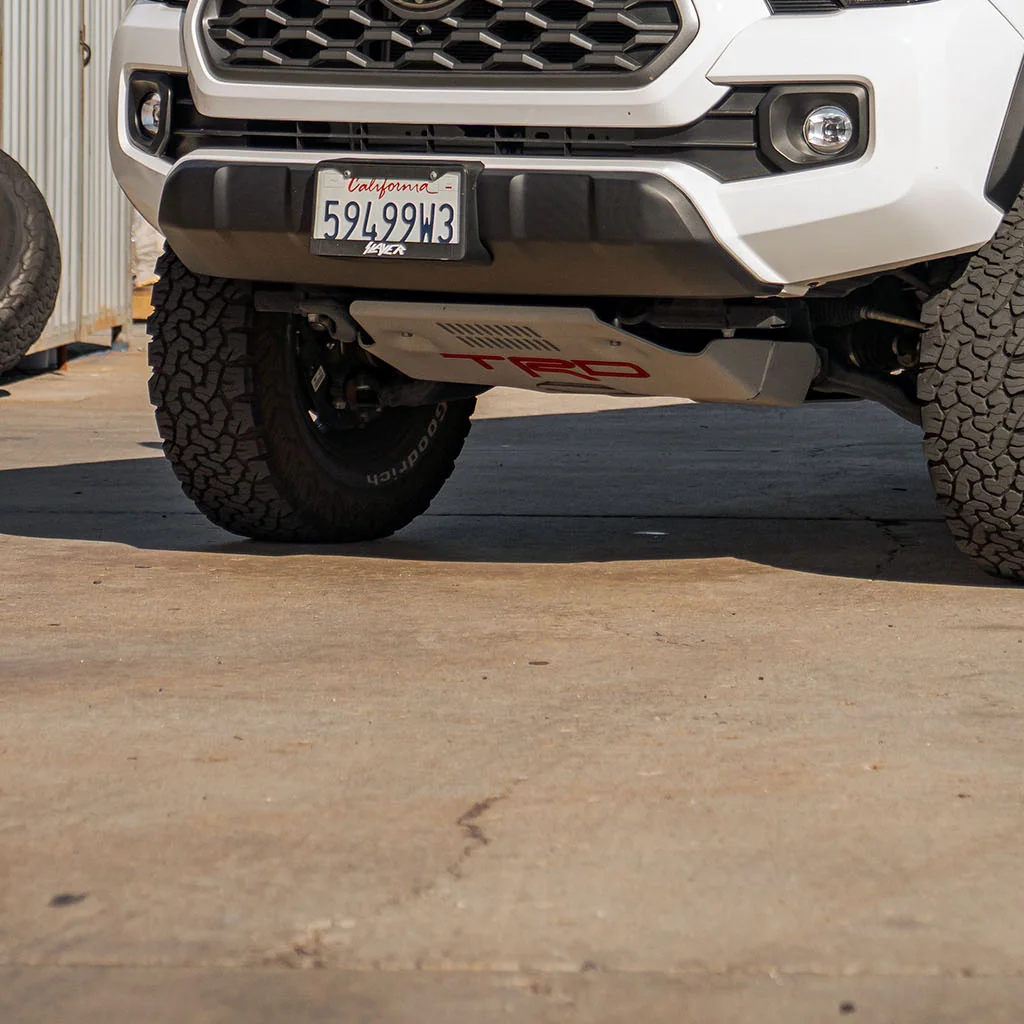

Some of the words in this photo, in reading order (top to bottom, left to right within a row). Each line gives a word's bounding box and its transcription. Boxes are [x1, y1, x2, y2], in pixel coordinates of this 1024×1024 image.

[347, 177, 438, 199] California
[324, 200, 455, 244] 59499W3
[362, 241, 407, 257] SLAYER
[440, 353, 651, 382] TRD
